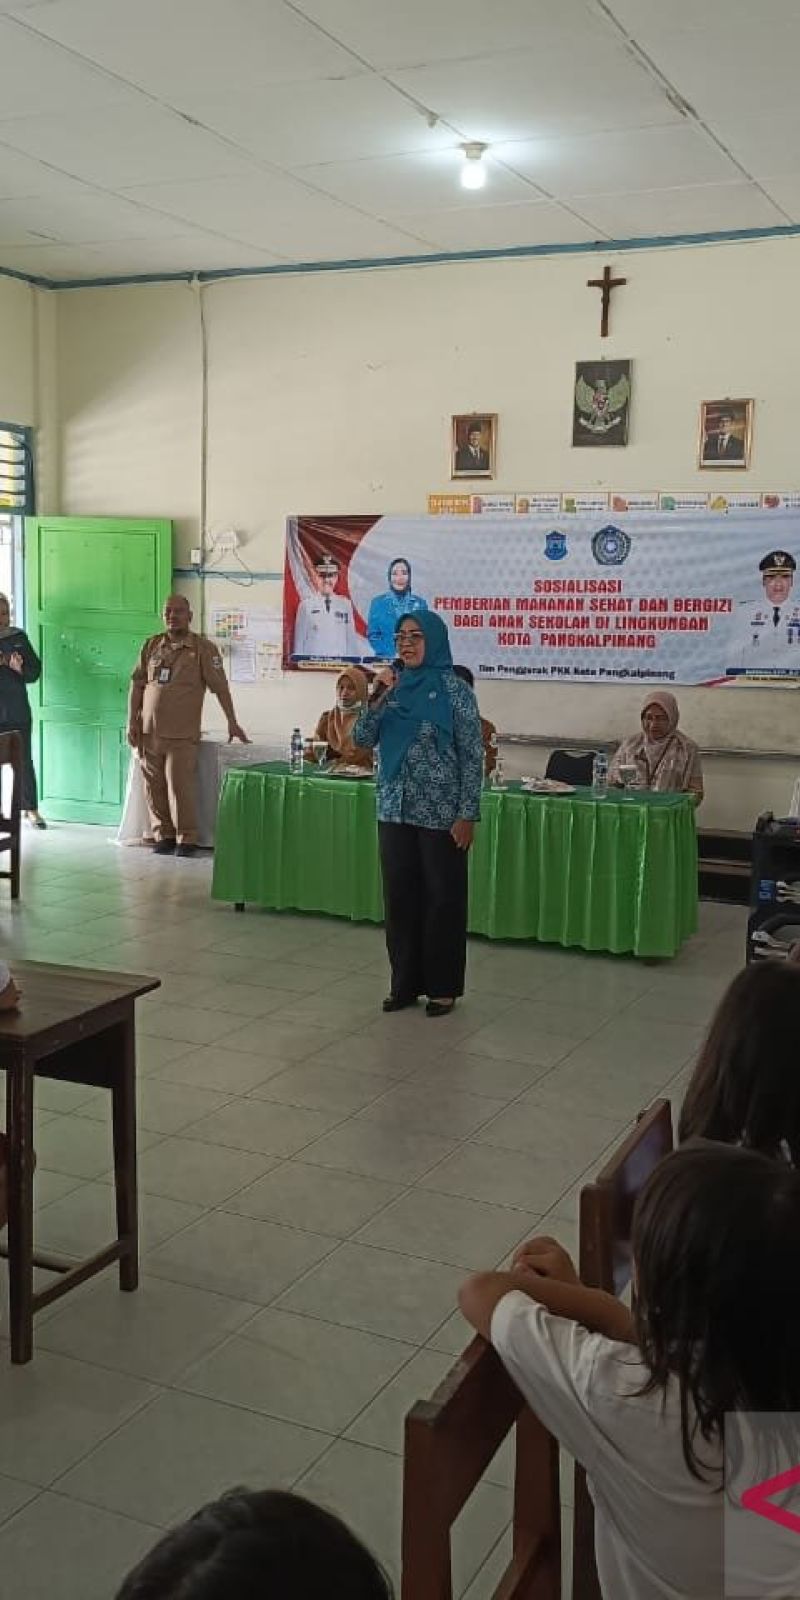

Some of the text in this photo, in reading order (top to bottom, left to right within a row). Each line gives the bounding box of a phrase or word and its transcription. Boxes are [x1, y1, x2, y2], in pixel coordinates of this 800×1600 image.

[534, 579, 622, 593] SOSIALISASI
[434, 597, 732, 613] PEMBERIAN MAKANAN SEHAT DAN BERGIZI
[453, 615, 709, 631] BAGI ANAK SEKOLAH DI LINGKUNGAN
[498, 633, 656, 648] KOTA PANGKALPINANG
[479, 665, 495, 673] Tim
[551, 667, 571, 675] PKK
[574, 667, 597, 675] Kota
